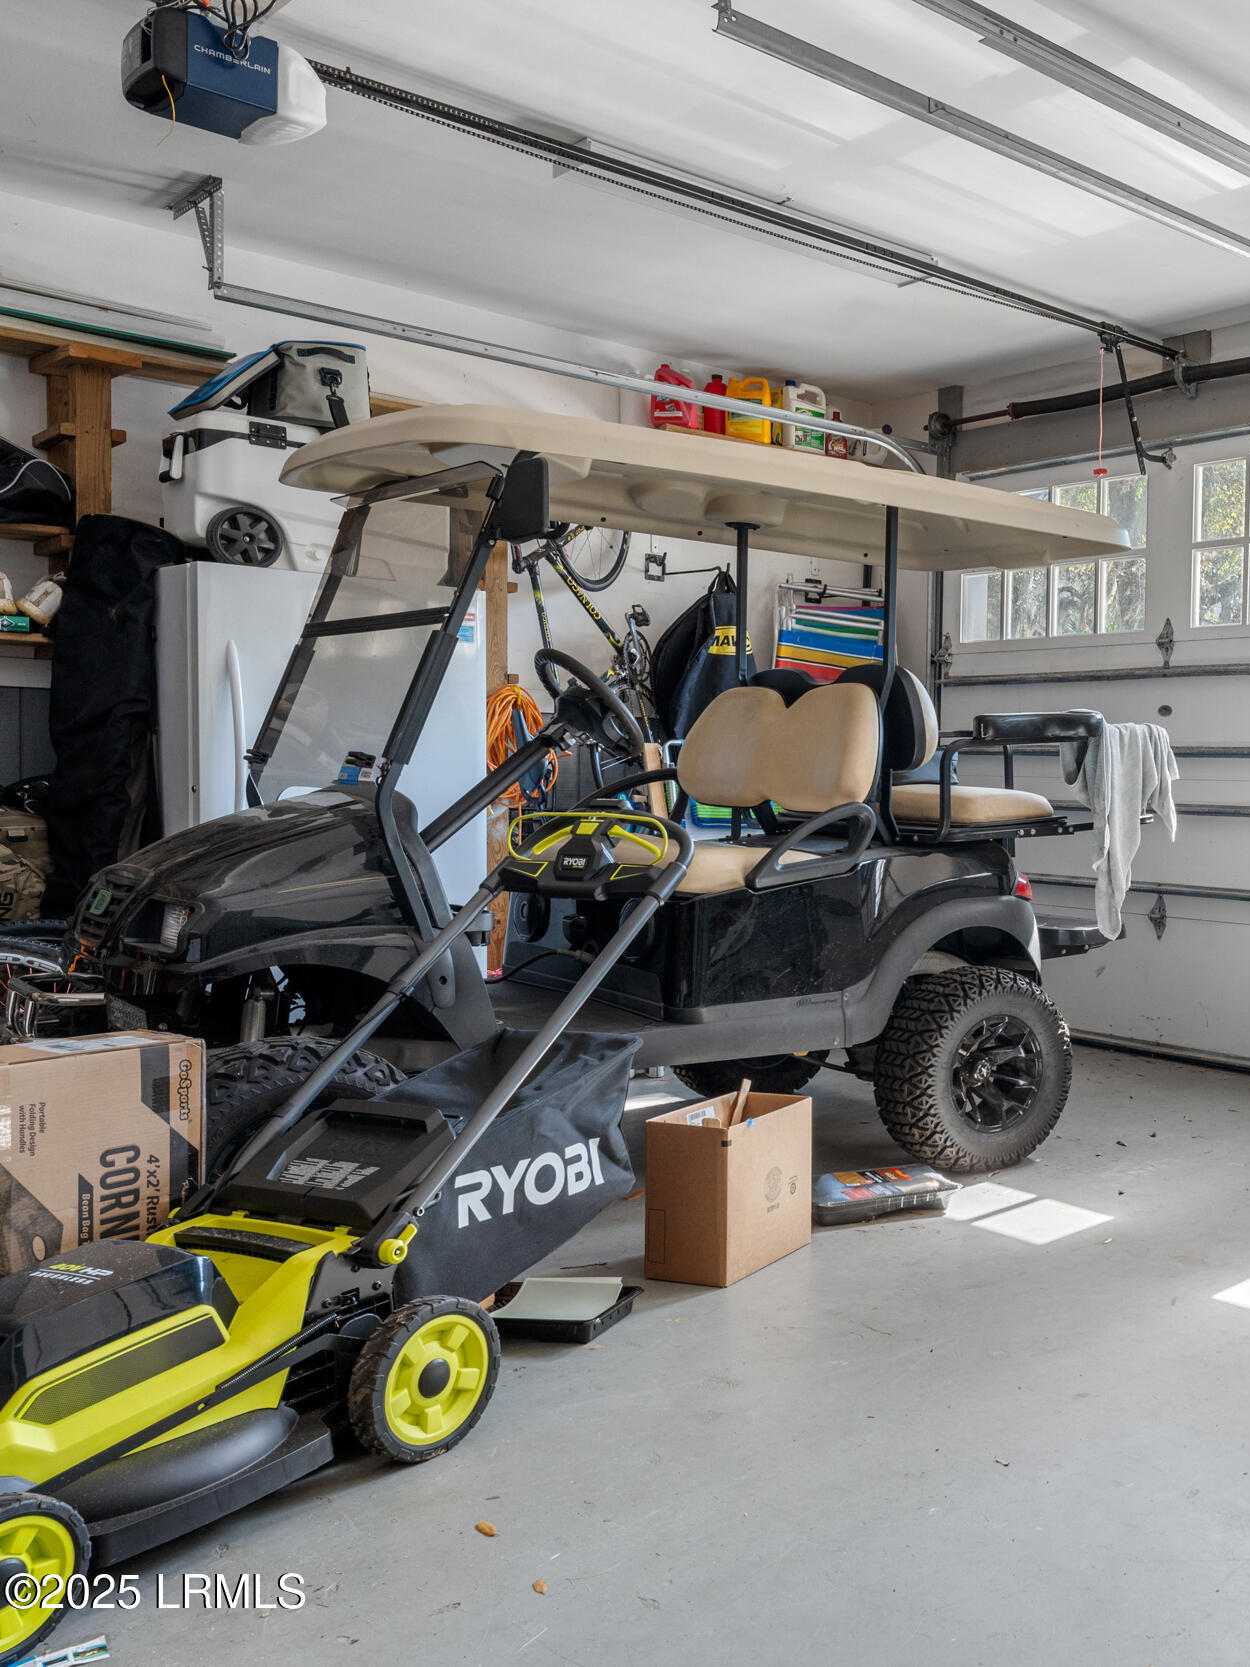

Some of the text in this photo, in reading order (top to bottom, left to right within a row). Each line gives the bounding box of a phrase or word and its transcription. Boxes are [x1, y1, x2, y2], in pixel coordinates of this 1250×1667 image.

[193, 44, 271, 75] CHAMBERLAIN
[562, 857, 586, 866] RYOBI
[177, 1058, 193, 1121] GoSports
[19, 1124, 27, 1154] Handles
[27, 1103, 37, 1157] Folding Design
[99, 1144, 141, 1241] CORN
[454, 1137, 605, 1229] RYOBI
[82, 1193, 91, 1218] Bean
[146, 1195, 160, 1237] Rust
[80, 1220, 91, 1239] Bag
